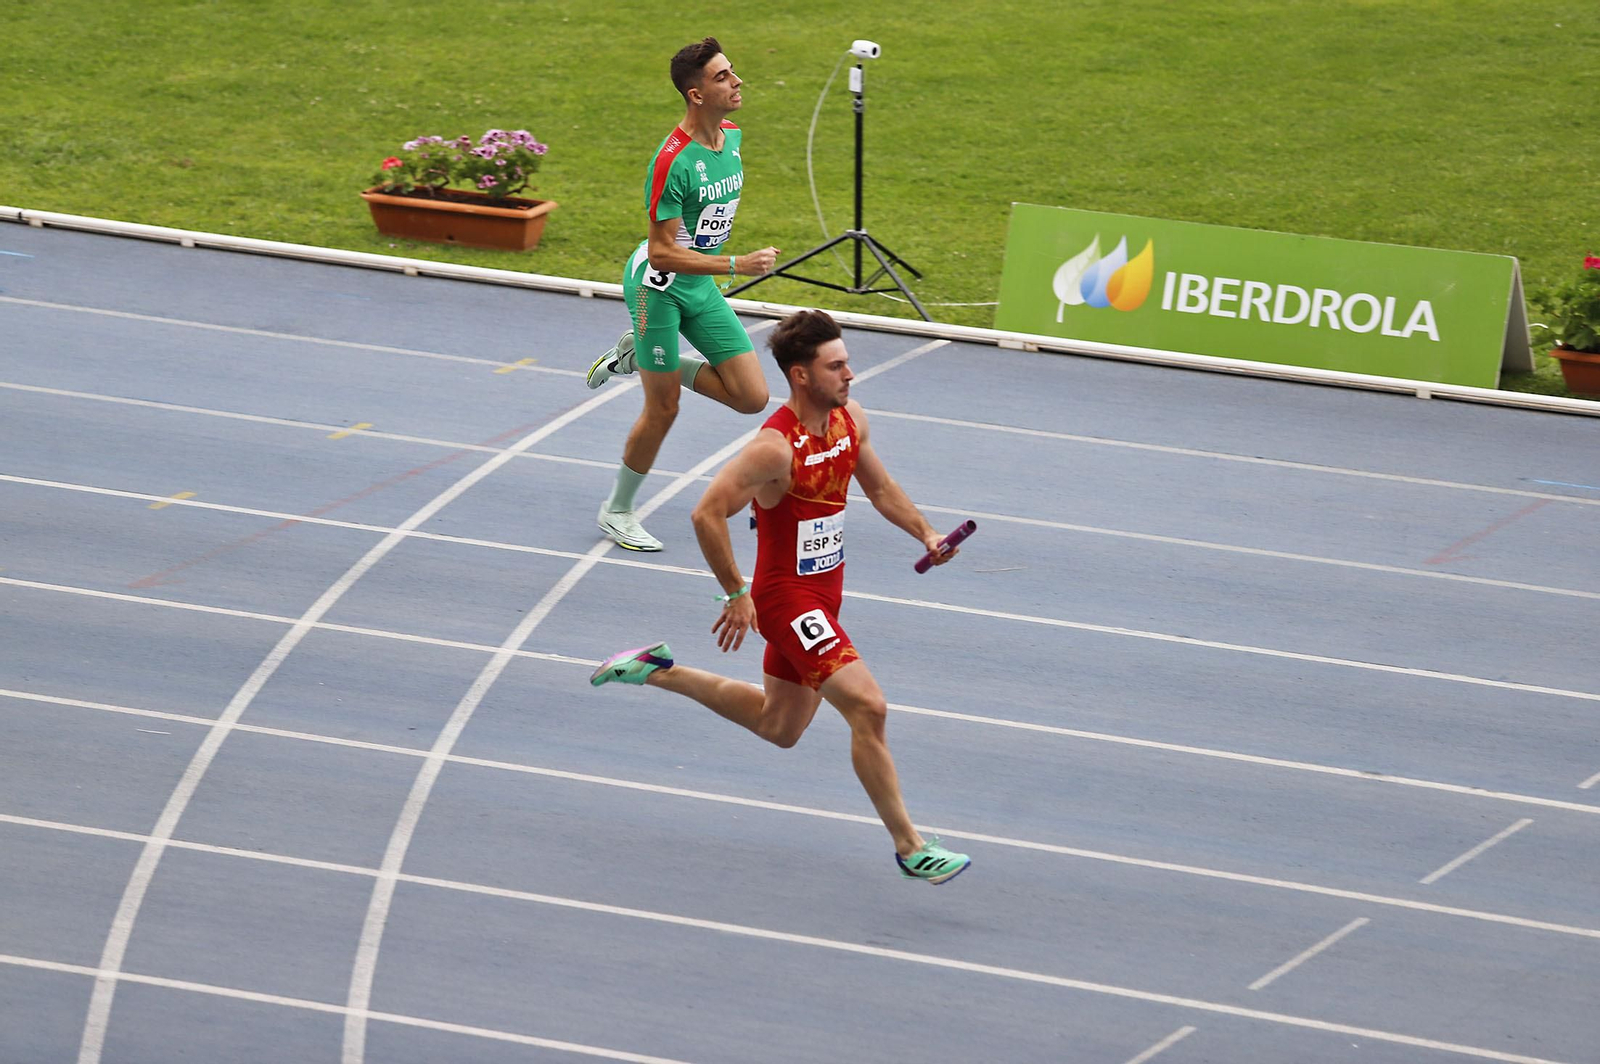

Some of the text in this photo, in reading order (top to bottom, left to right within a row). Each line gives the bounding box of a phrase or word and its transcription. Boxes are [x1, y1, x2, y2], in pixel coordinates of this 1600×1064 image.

[701, 219, 727, 230] POR
[650, 270, 669, 287] 3
[1161, 271, 1440, 342] IBERDROLA
[803, 536, 829, 552] ESP
[800, 616, 825, 640] 6
